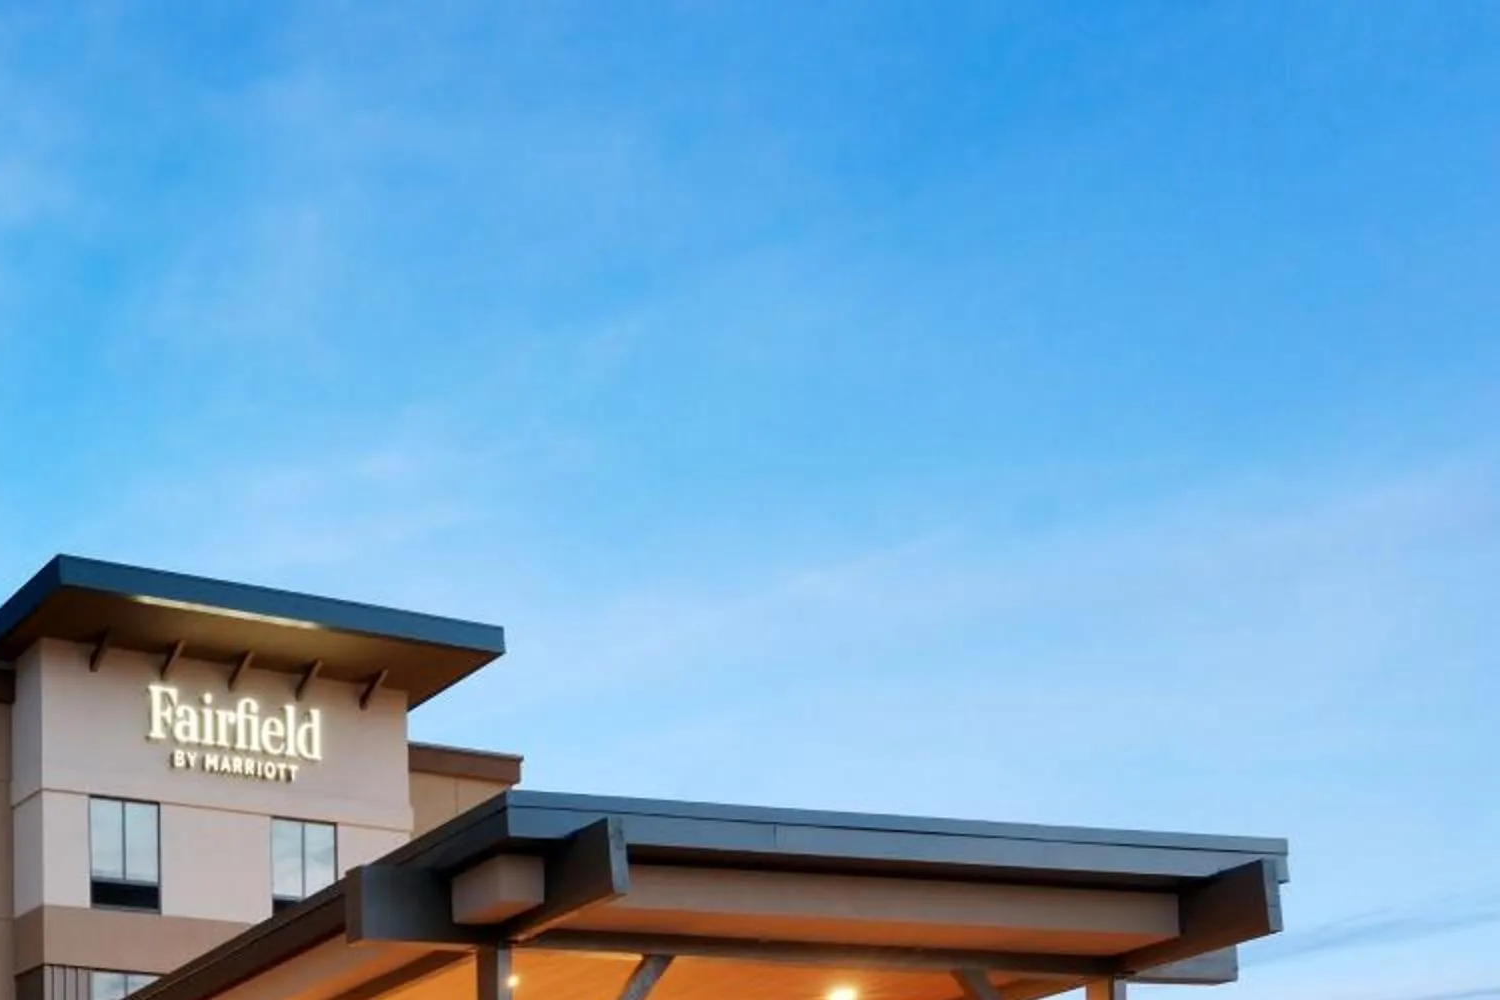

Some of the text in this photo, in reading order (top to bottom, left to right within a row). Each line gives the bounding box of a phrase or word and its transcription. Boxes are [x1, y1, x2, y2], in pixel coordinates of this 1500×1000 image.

[147, 684, 322, 761] Fairfield
[173, 749, 298, 782] BY MARRIOTT
